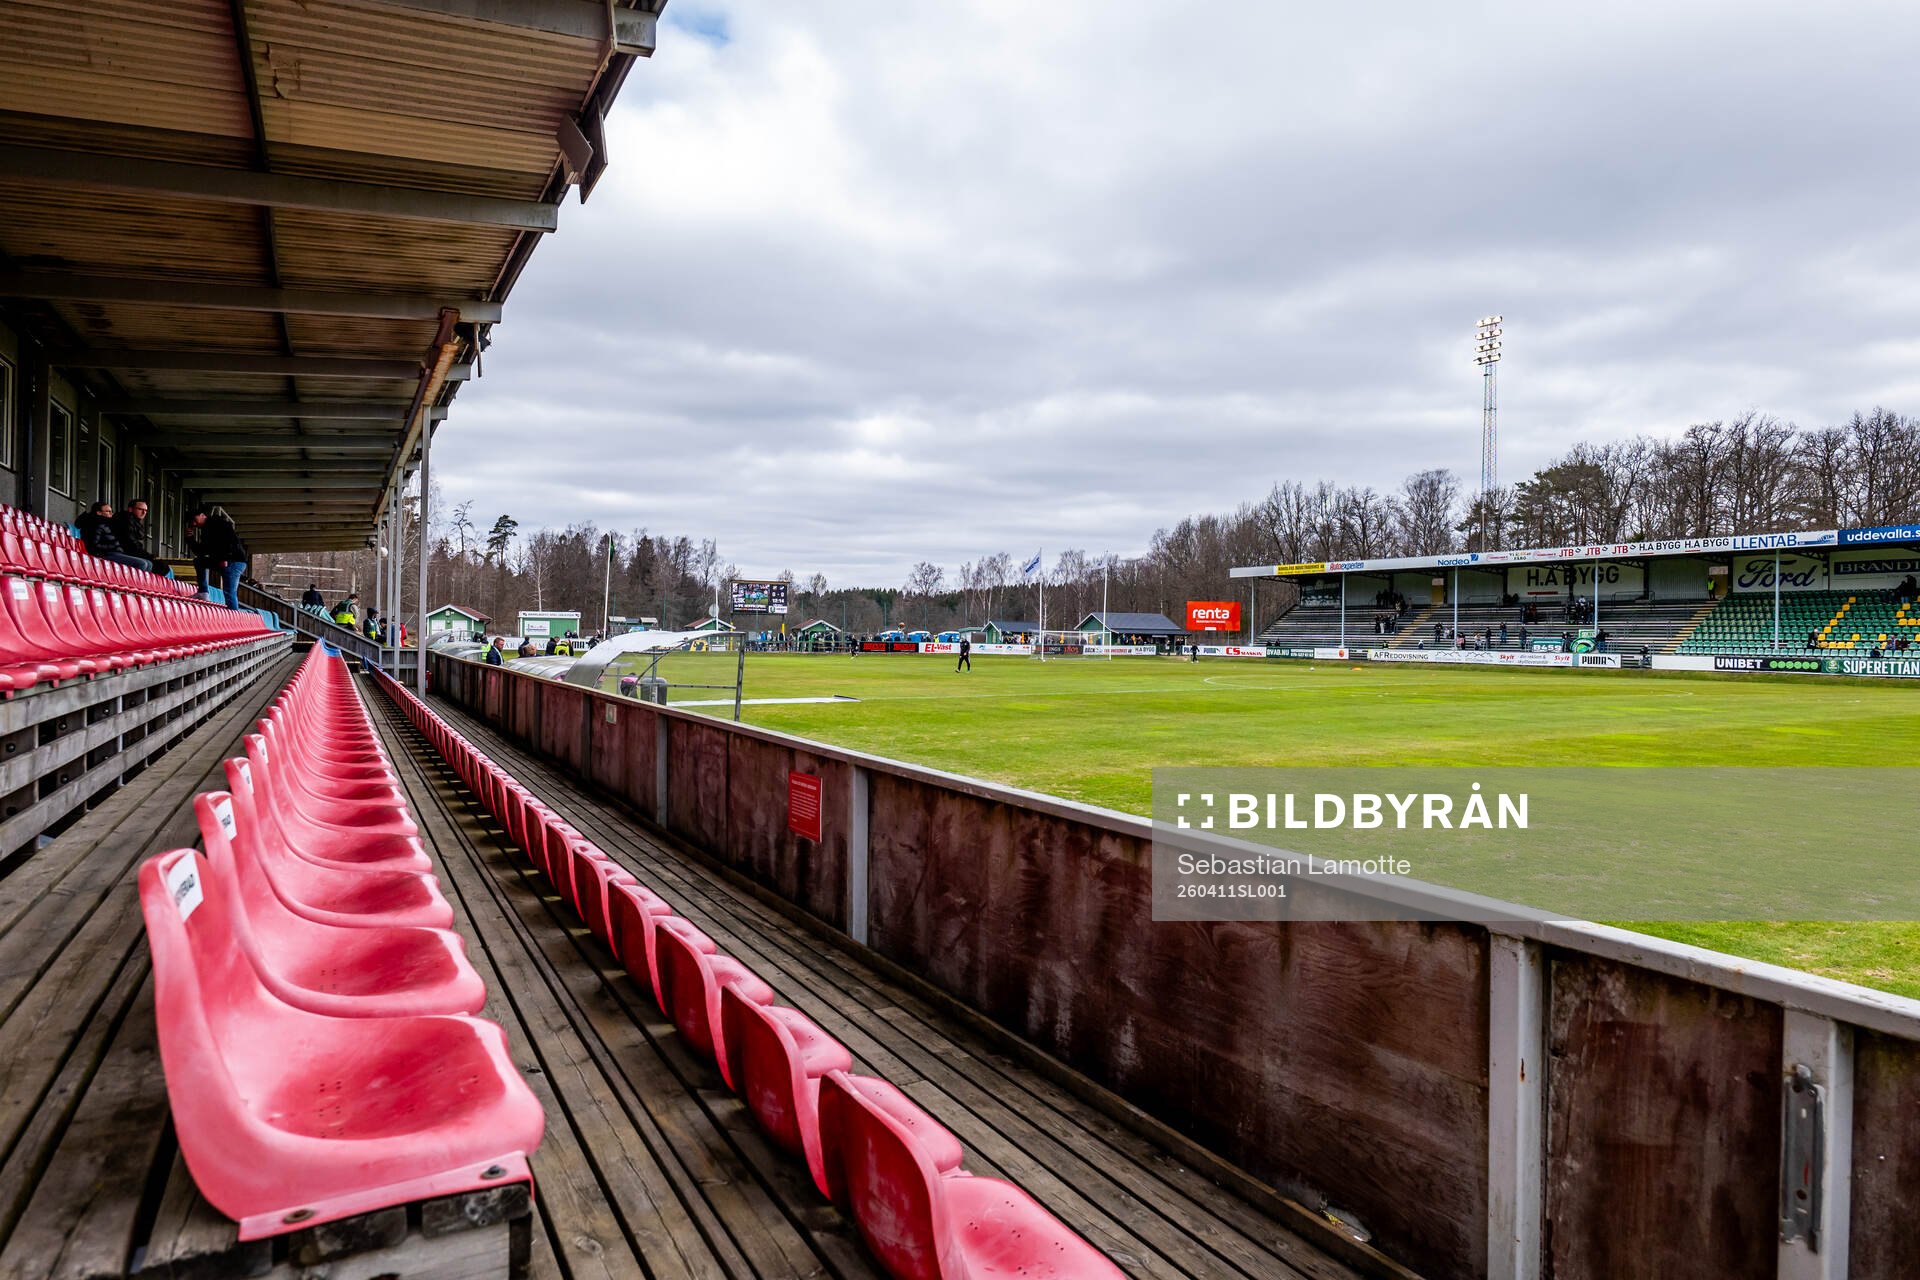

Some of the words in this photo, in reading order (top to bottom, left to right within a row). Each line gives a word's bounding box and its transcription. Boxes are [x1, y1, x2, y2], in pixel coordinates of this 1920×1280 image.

[1656, 541, 1680, 550] BYGG
[1684, 540, 1700, 548] H.A
[1703, 538, 1729, 547] BYGG
[1733, 534, 1797, 549] LLENTAB
[1559, 549, 1574, 557] JTB
[1585, 547, 1600, 556] JTB
[1612, 545, 1628, 554] JTB
[1527, 568, 1558, 587] H.A
[1563, 565, 1619, 586] BYGG
[1738, 559, 1817, 588] Ford
[1192, 607, 1230, 619] renta
[1226, 647, 1240, 655] CS
[1582, 656, 1607, 665] PUMA
[1716, 658, 1763, 669] UNIBET
[1843, 660, 1919, 675] SUPERETTAN
